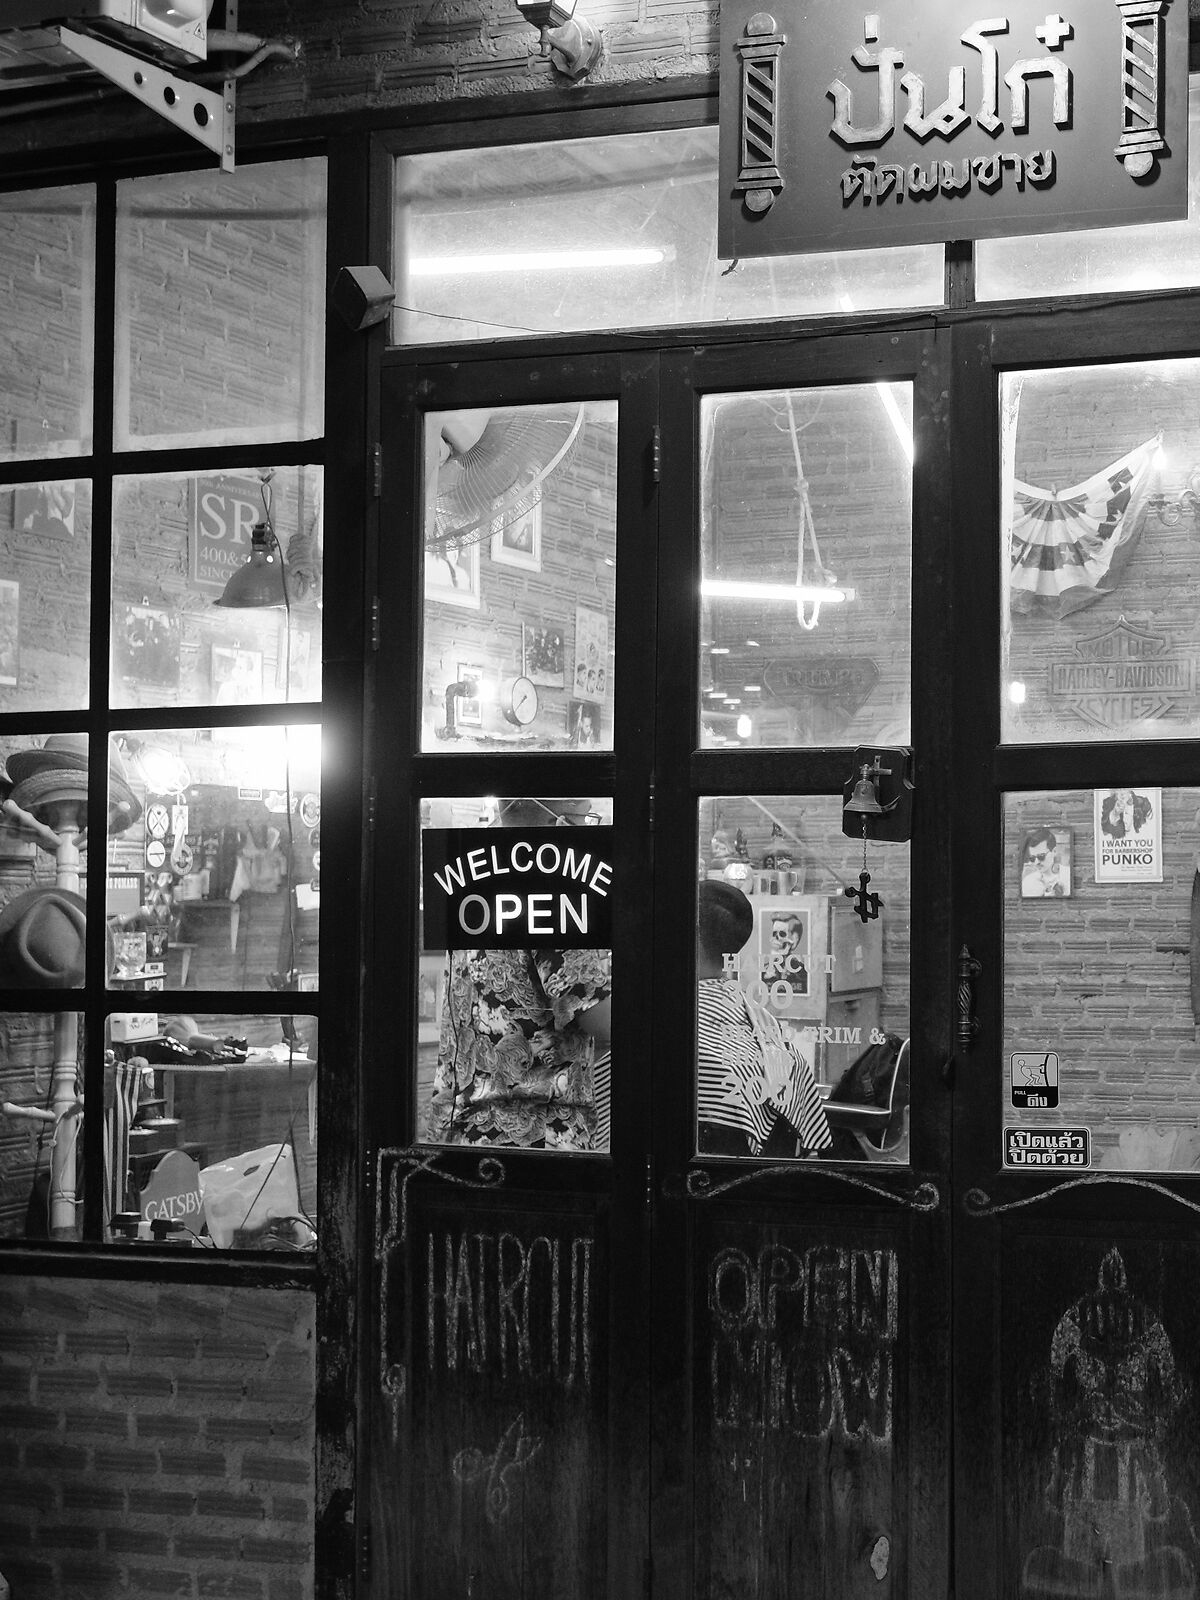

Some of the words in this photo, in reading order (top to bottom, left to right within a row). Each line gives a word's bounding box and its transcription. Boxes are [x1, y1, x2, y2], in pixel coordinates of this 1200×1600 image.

[841, 149, 1057, 203] ตัดผมชาย
[200, 492, 260, 545] SR
[1106, 840, 1133, 848] WANT
[1134, 839, 1153, 848] YOU
[433, 841, 614, 897] WELCOME
[1102, 853, 1153, 865] PUNKO
[458, 893, 588, 935] OPEN
[722, 980, 794, 1010] 300
[803, 1026, 862, 1044] TRIM
[869, 1027, 887, 1045] &
[721, 1075, 794, 1106] 200
[1027, 1093, 1048, 1107] ดึง
[1010, 1131, 1084, 1148] เปิดแล้ว
[1008, 1148, 1084, 1164] ปิดด้วย
[144, 1189, 205, 1220] GATSBY
[708, 1243, 899, 1340] OPEN
